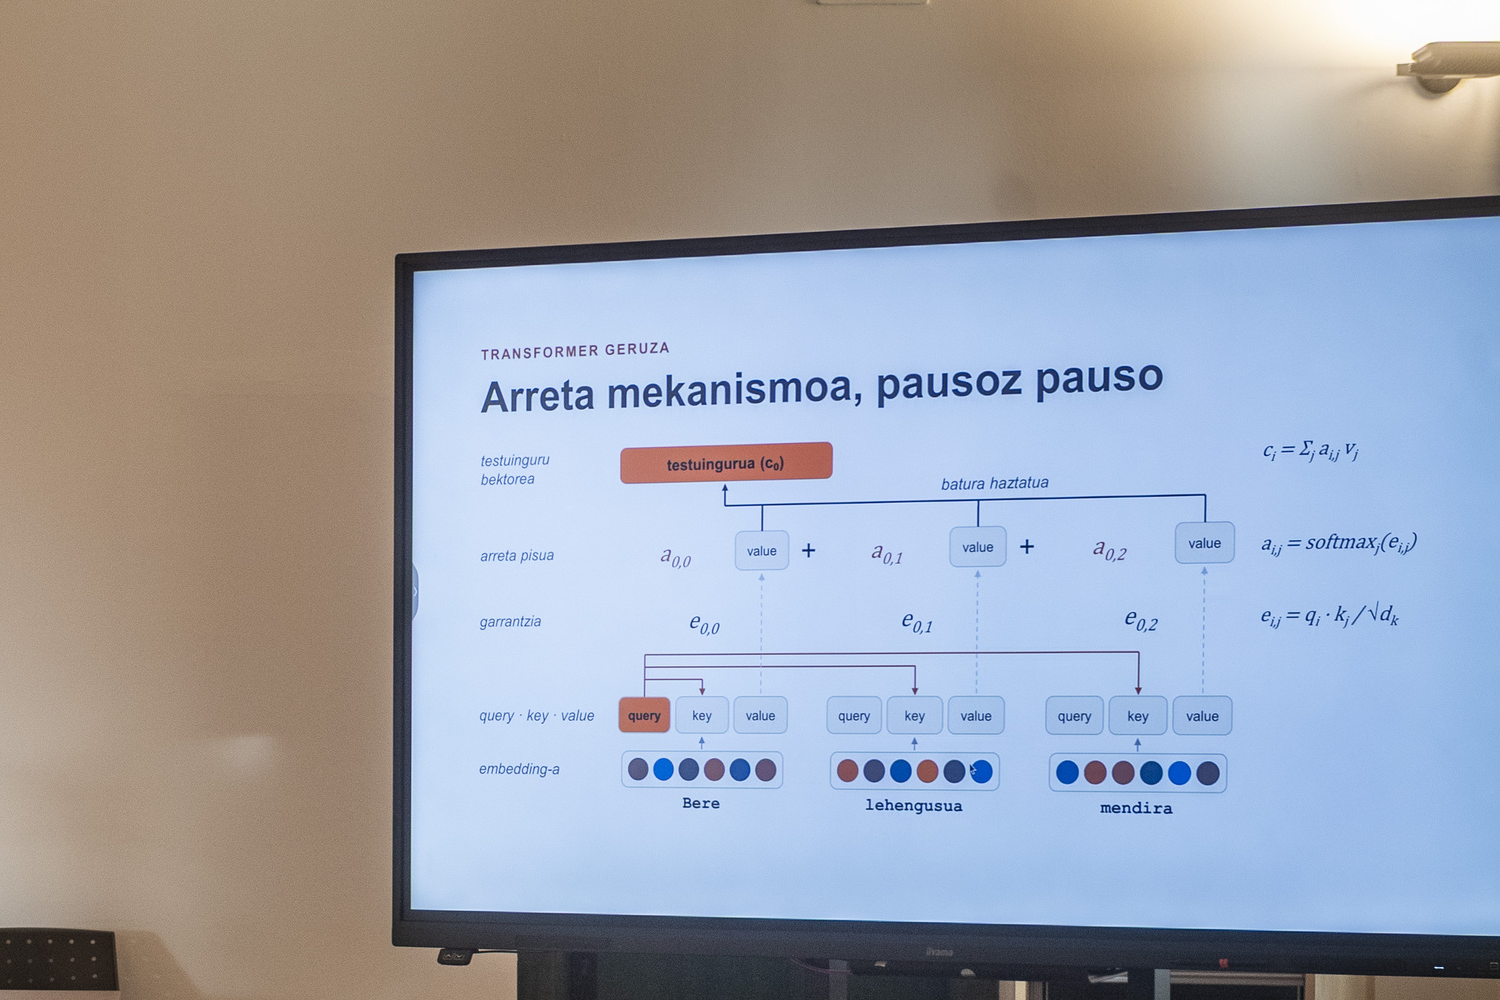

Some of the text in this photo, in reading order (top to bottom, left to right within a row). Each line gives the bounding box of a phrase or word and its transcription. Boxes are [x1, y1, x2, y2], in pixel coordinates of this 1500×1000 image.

[480, 340, 670, 361] TRANSFORMER GERUZA
[480, 363, 1164, 414] Arreta mekanismoa, pausoz pauso
[480, 453, 551, 470] testuinguru
[666, 456, 756, 474] testuingurua
[480, 472, 535, 486] bektorea
[941, 475, 1050, 491] batura haztatua
[962, 540, 994, 553] value
[1188, 536, 1222, 549] value
[480, 549, 555, 565] arreta pisua
[746, 544, 778, 557] value
[479, 614, 542, 631] garrantzia
[479, 710, 515, 725] query
[526, 708, 550, 725] key
[561, 708, 595, 722] value
[627, 711, 662, 724] query
[692, 709, 713, 724] key
[745, 709, 776, 722] value
[838, 711, 871, 724] query
[904, 709, 926, 725] key
[960, 709, 993, 722] value
[1057, 711, 1092, 725] query
[1127, 709, 1150, 725] key
[1186, 709, 1220, 722] value
[478, 761, 560, 779] embedding-a
[682, 796, 721, 810] Bere
[865, 797, 964, 816] lehengusua
[1100, 800, 1174, 815] mendira
